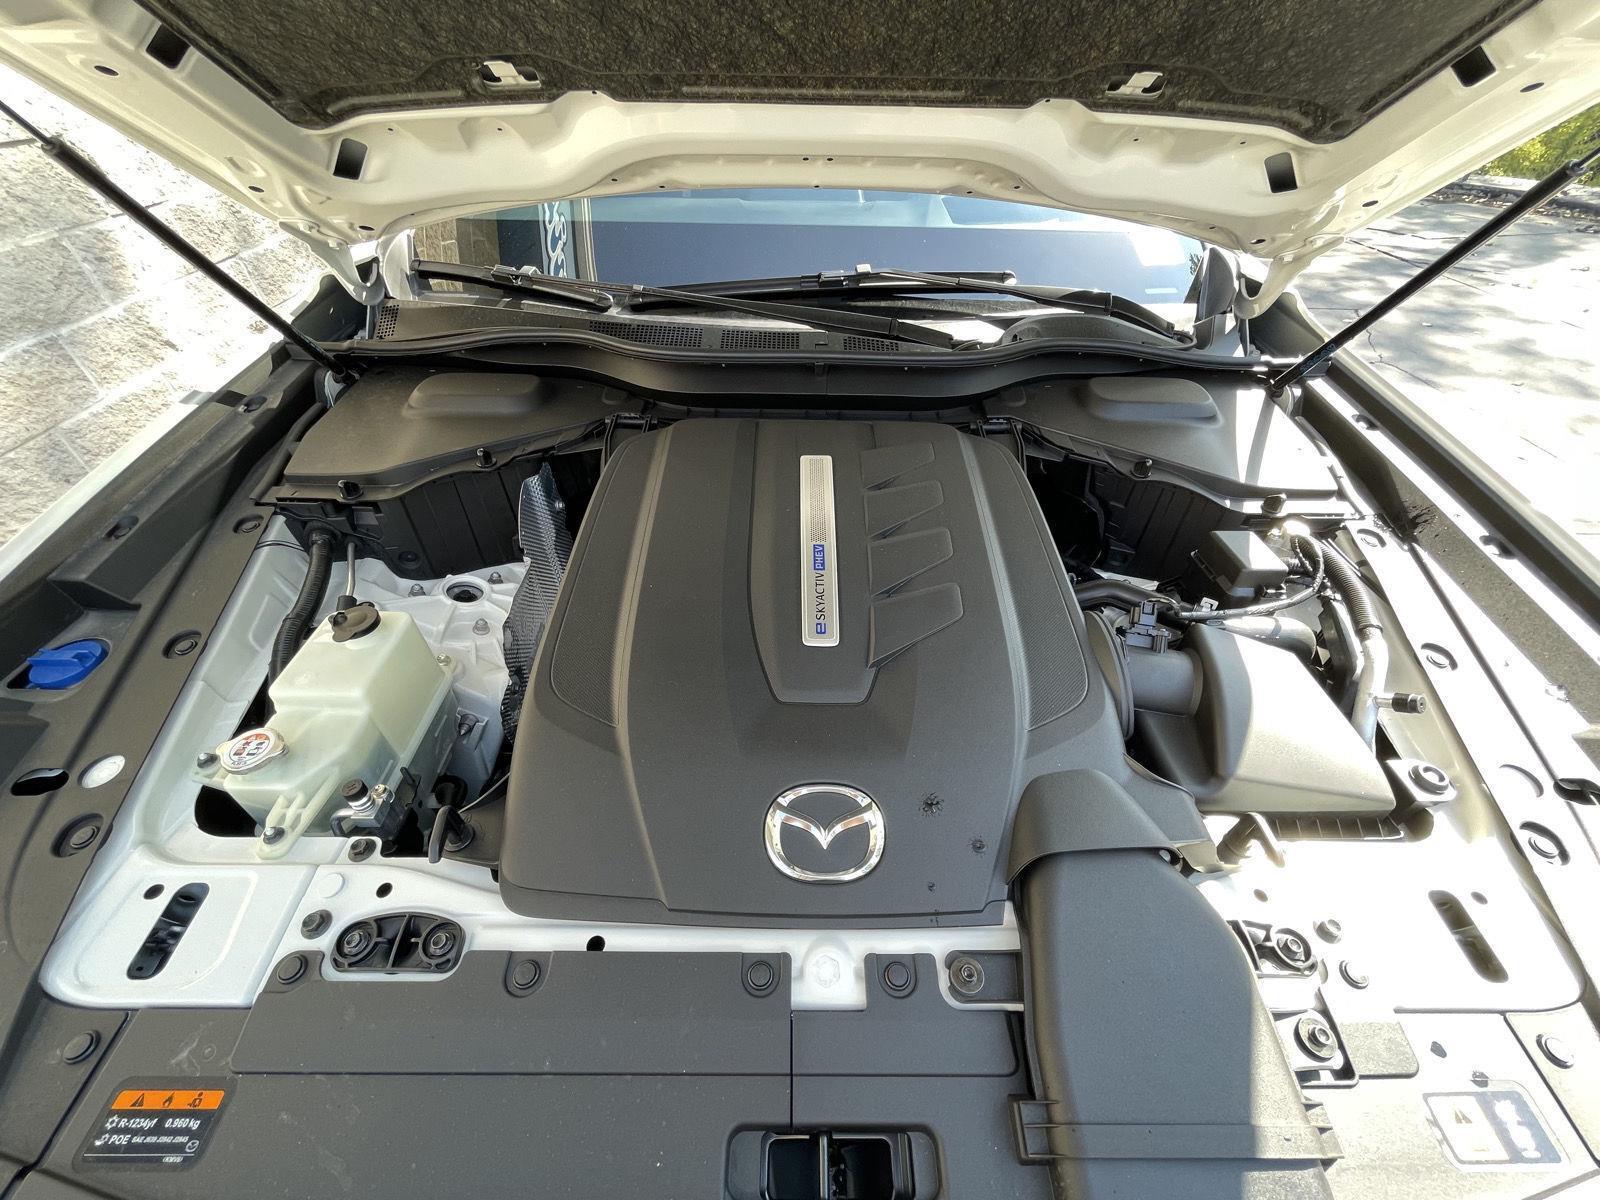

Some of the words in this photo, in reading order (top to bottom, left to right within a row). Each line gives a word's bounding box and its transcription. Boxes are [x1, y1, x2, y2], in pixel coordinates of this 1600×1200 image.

[815, 545, 824, 569] PHEV
[815, 572, 826, 621] SKYACTIV
[118, 1118, 158, 1130] R-1234yf
[189, 1118, 200, 1130] kg
[108, 1134, 131, 1145] POE
